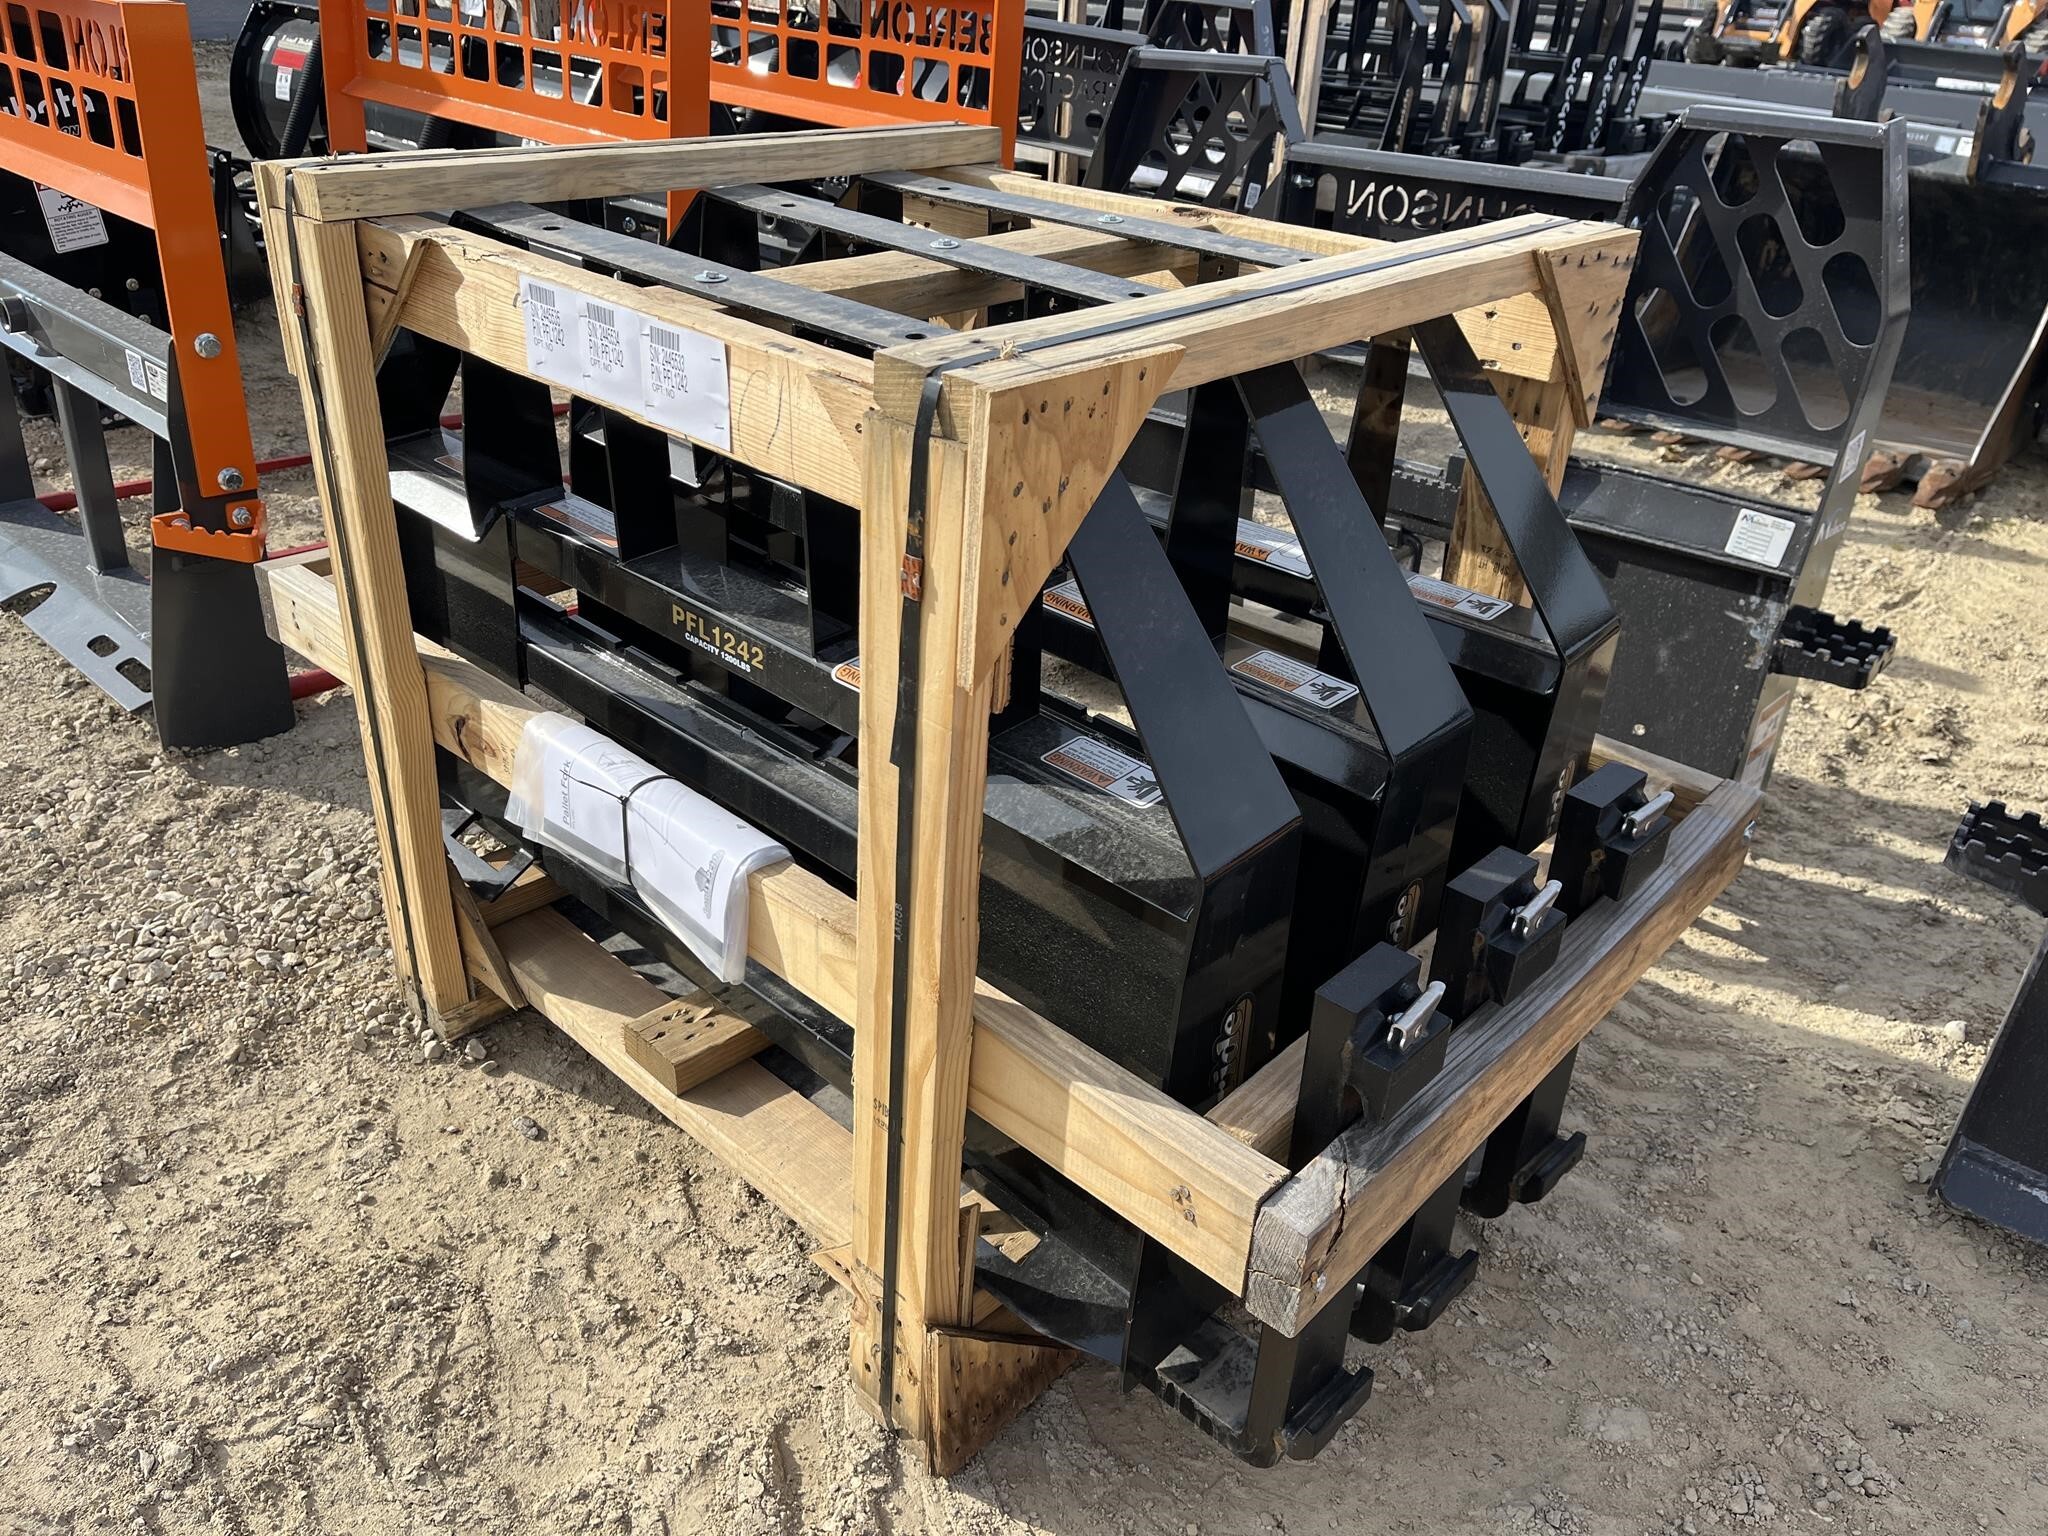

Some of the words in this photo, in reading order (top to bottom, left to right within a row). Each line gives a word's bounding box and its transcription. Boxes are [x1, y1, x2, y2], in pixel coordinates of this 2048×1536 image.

[542, 322, 566, 347] PFL1242
[601, 343, 624, 368] PFL1242
[663, 368, 689, 394] PFL1242
[672, 603, 765, 671] PFL1242
[685, 631, 720, 657] CAPACITY
[720, 650, 751, 673] 1200LBS
[1238, 663, 1289, 688] WARNING
[561, 760, 571, 789] Fork
[1048, 752, 1101, 781] WARNING
[562, 791, 570, 826] Pallet
